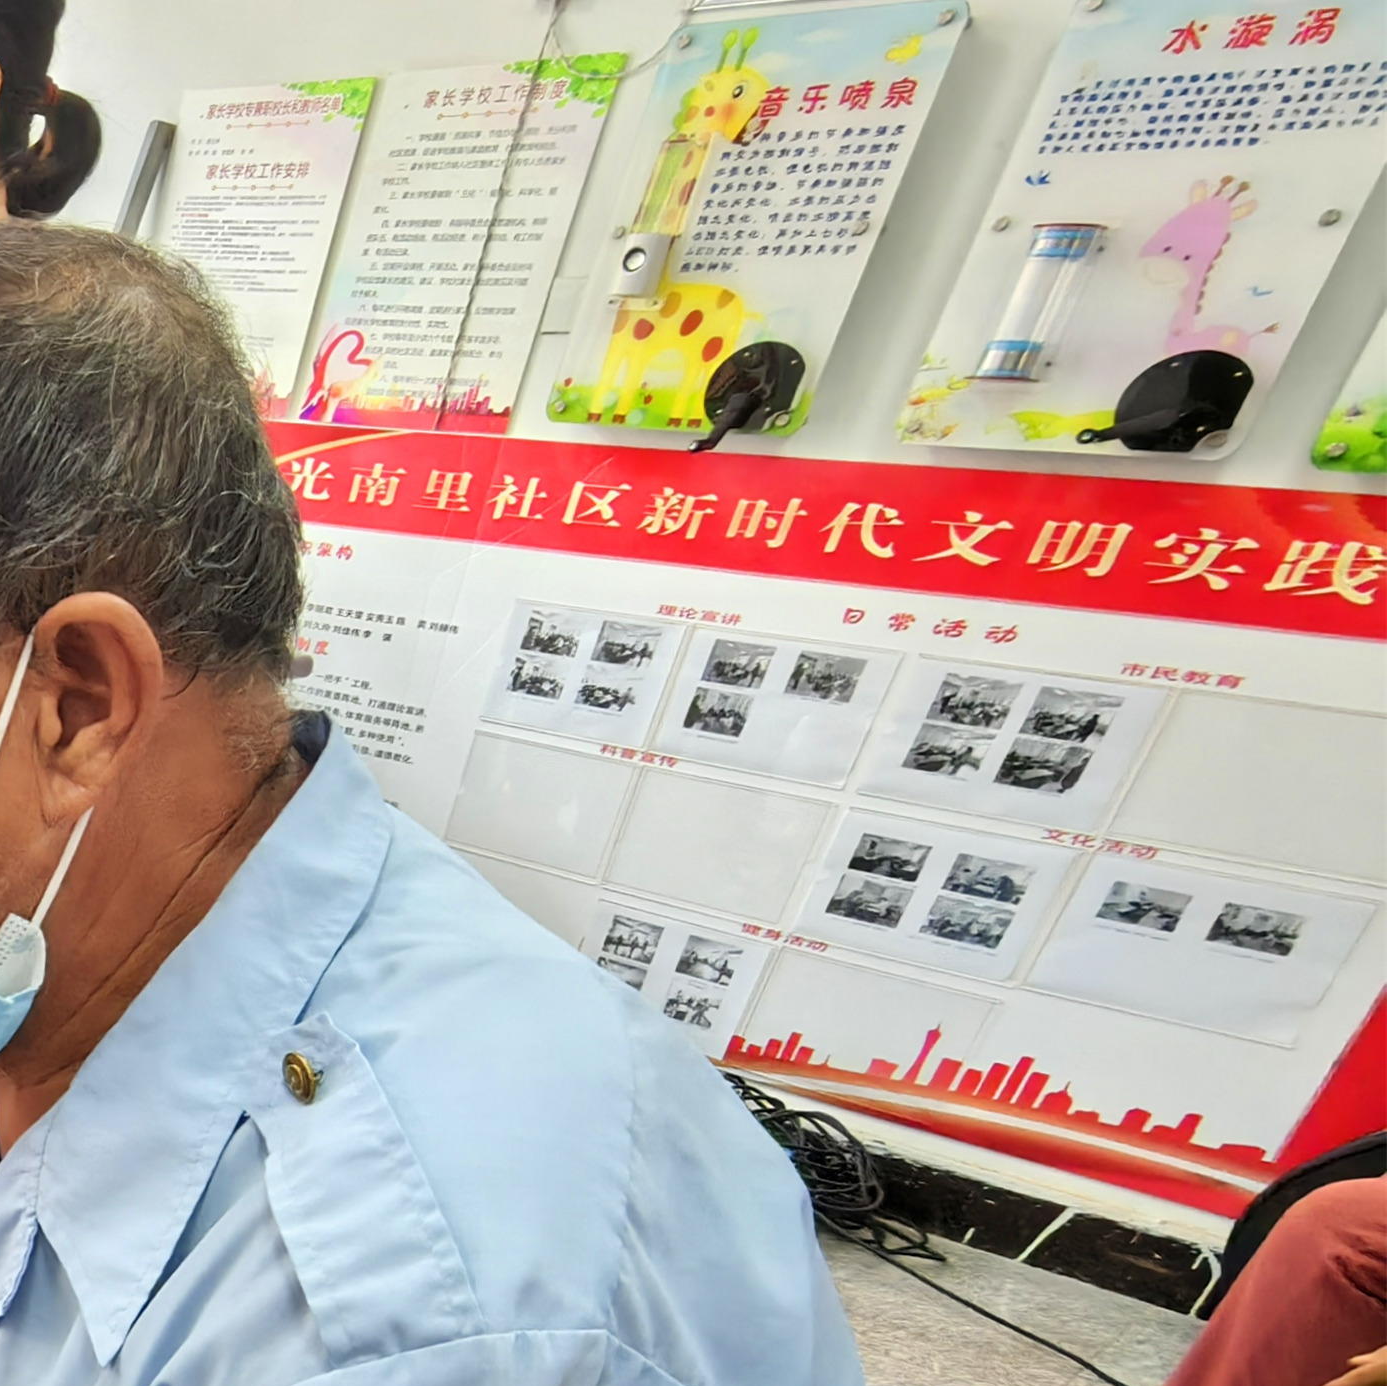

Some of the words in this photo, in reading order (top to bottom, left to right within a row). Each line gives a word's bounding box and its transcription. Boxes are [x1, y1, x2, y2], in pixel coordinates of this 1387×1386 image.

[1161, 8, 1341, 54] 水漩涡
[423, 80, 570, 109] 家长学校工作制度
[757, 77, 919, 118] 音乐喷泉
[206, 162, 310, 180] 家长学校工作安排
[285, 457, 1387, 606] 光南里社区新时代文明实践
[657, 603, 742, 626] 理论宣讲
[841, 607, 1020, 644] 日常活动
[1120, 662, 1246, 690] 市民教育
[598, 743, 679, 768] 科普宣传
[1041, 828, 1161, 860] 文化活动
[740, 922, 830, 953] 健身活动
